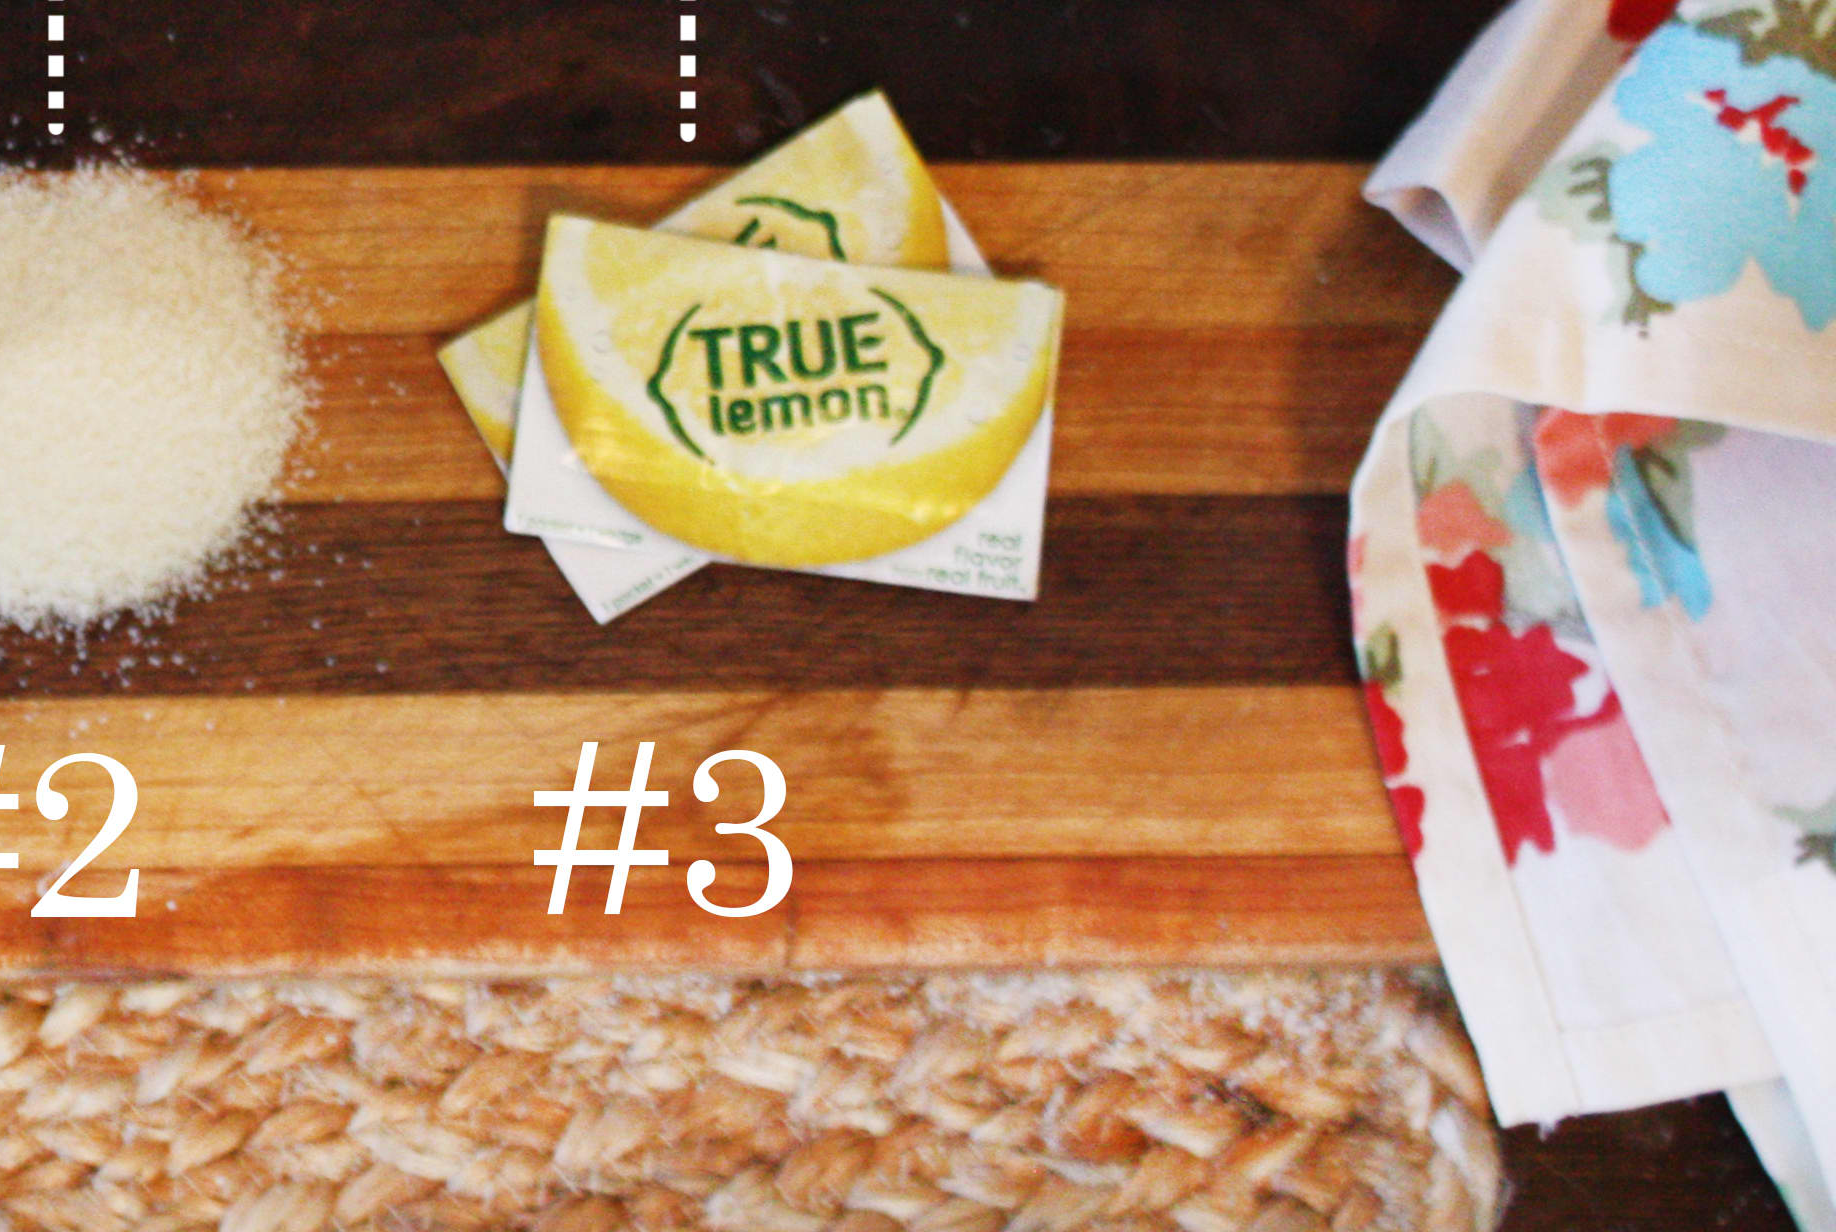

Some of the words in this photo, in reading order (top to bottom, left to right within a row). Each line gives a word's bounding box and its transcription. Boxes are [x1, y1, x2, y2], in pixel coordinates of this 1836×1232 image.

[687, 311, 888, 390] TRUE
[708, 383, 891, 436] lemon
[978, 532, 1022, 551] real
[927, 567, 972, 586] real
